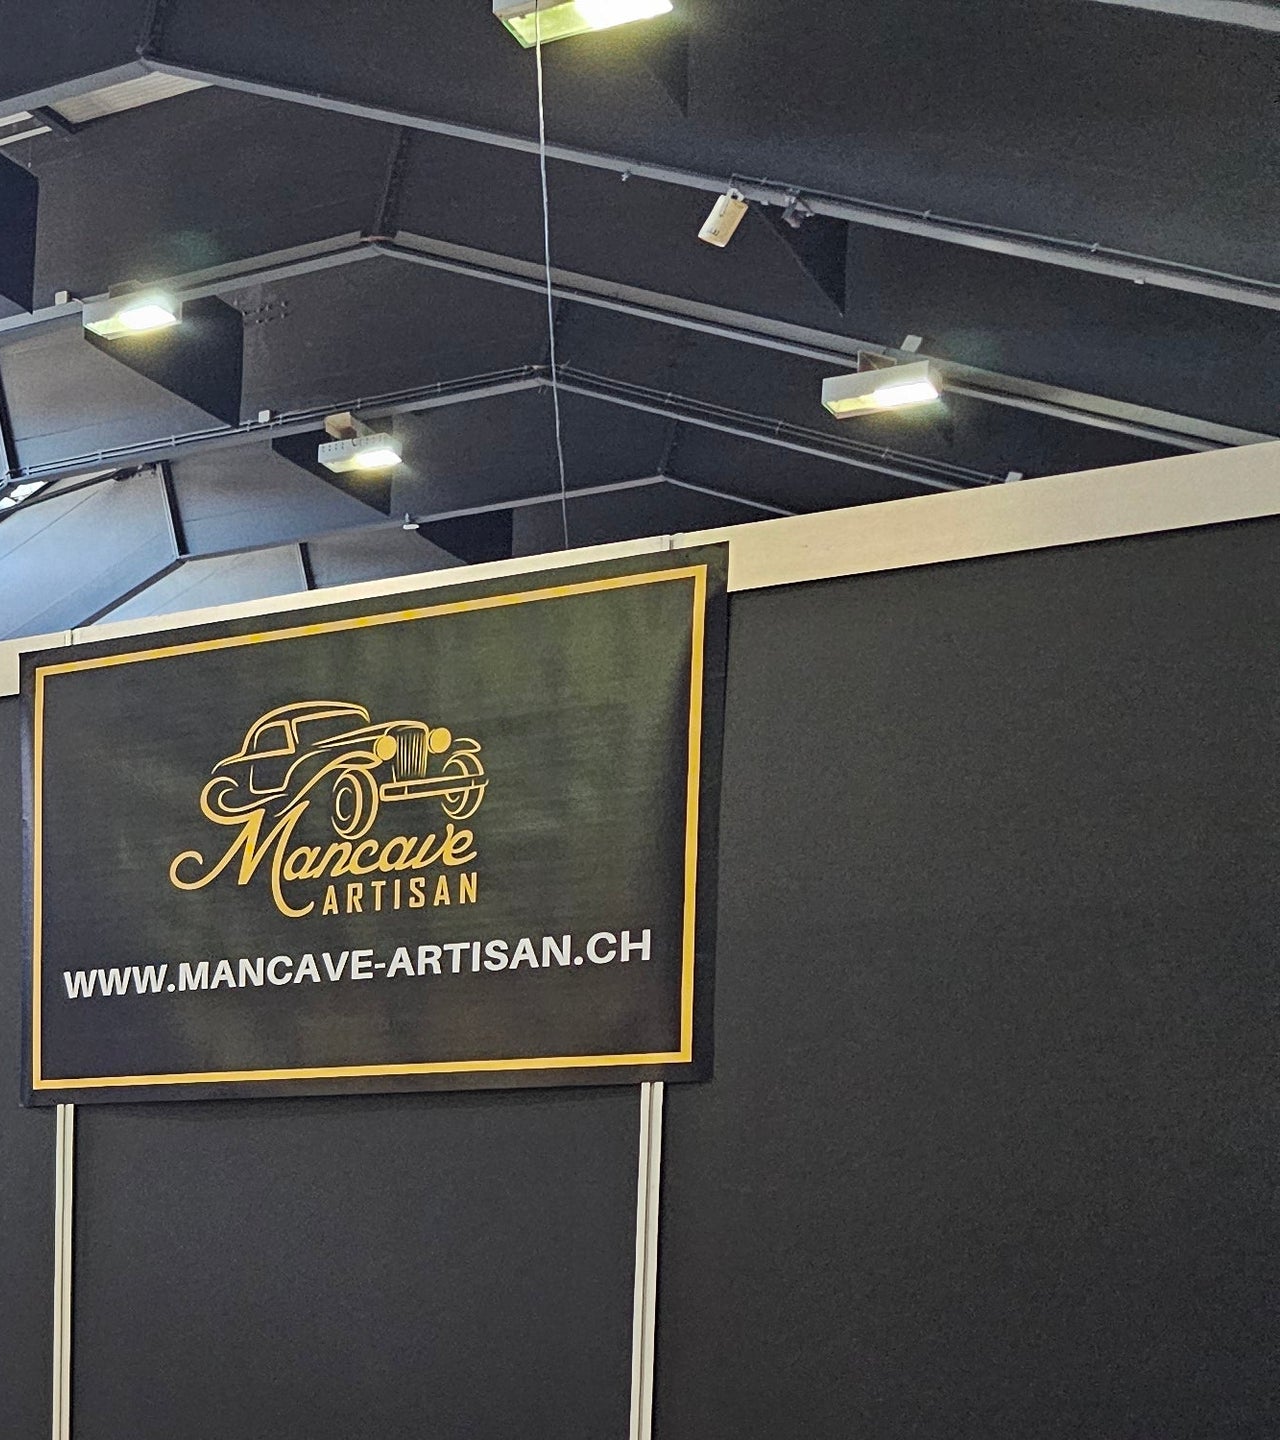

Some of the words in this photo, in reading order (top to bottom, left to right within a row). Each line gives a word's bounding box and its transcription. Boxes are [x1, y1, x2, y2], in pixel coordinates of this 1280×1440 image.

[169, 800, 477, 918] Mancave
[322, 871, 479, 916] ARTISAN
[63, 928, 652, 999] WWW.MANCAVE-ARTISAN.CH
